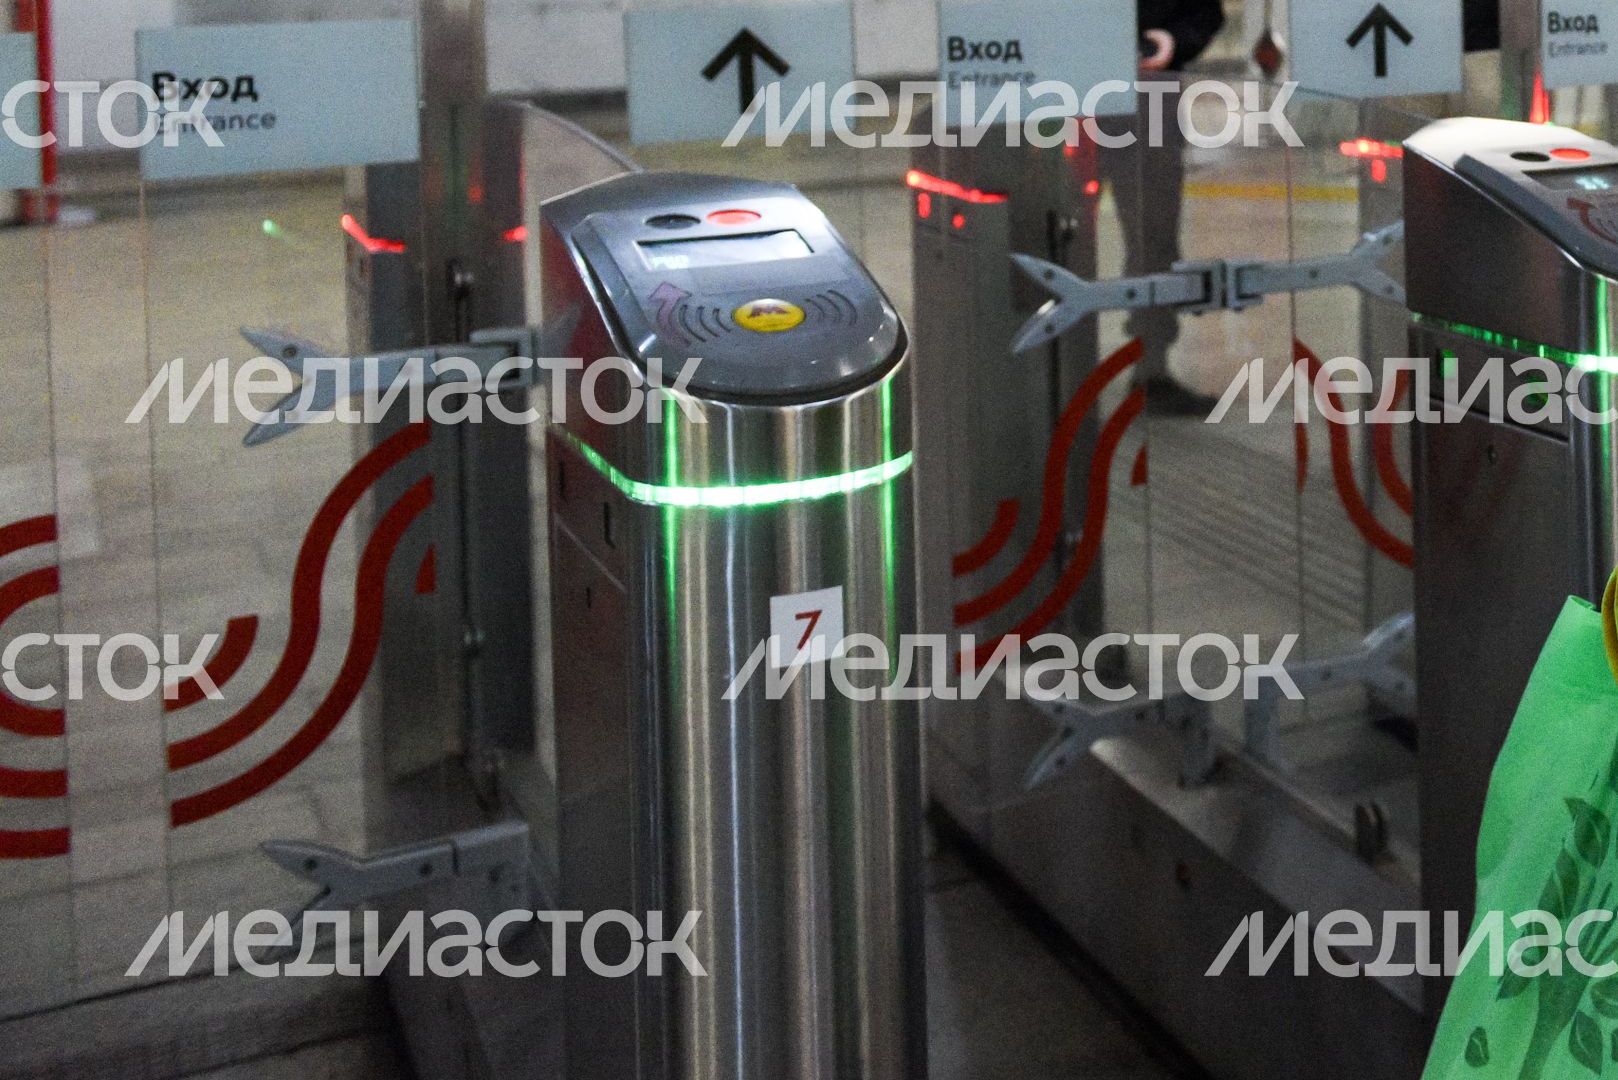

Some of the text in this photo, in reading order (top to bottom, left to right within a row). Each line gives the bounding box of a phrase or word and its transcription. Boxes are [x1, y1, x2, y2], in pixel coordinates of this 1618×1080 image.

[1547, 11, 1598, 34] Вход
[947, 36, 1023, 63] Вход
[152, 71, 259, 103] Вход
[795, 610, 822, 650] 7
